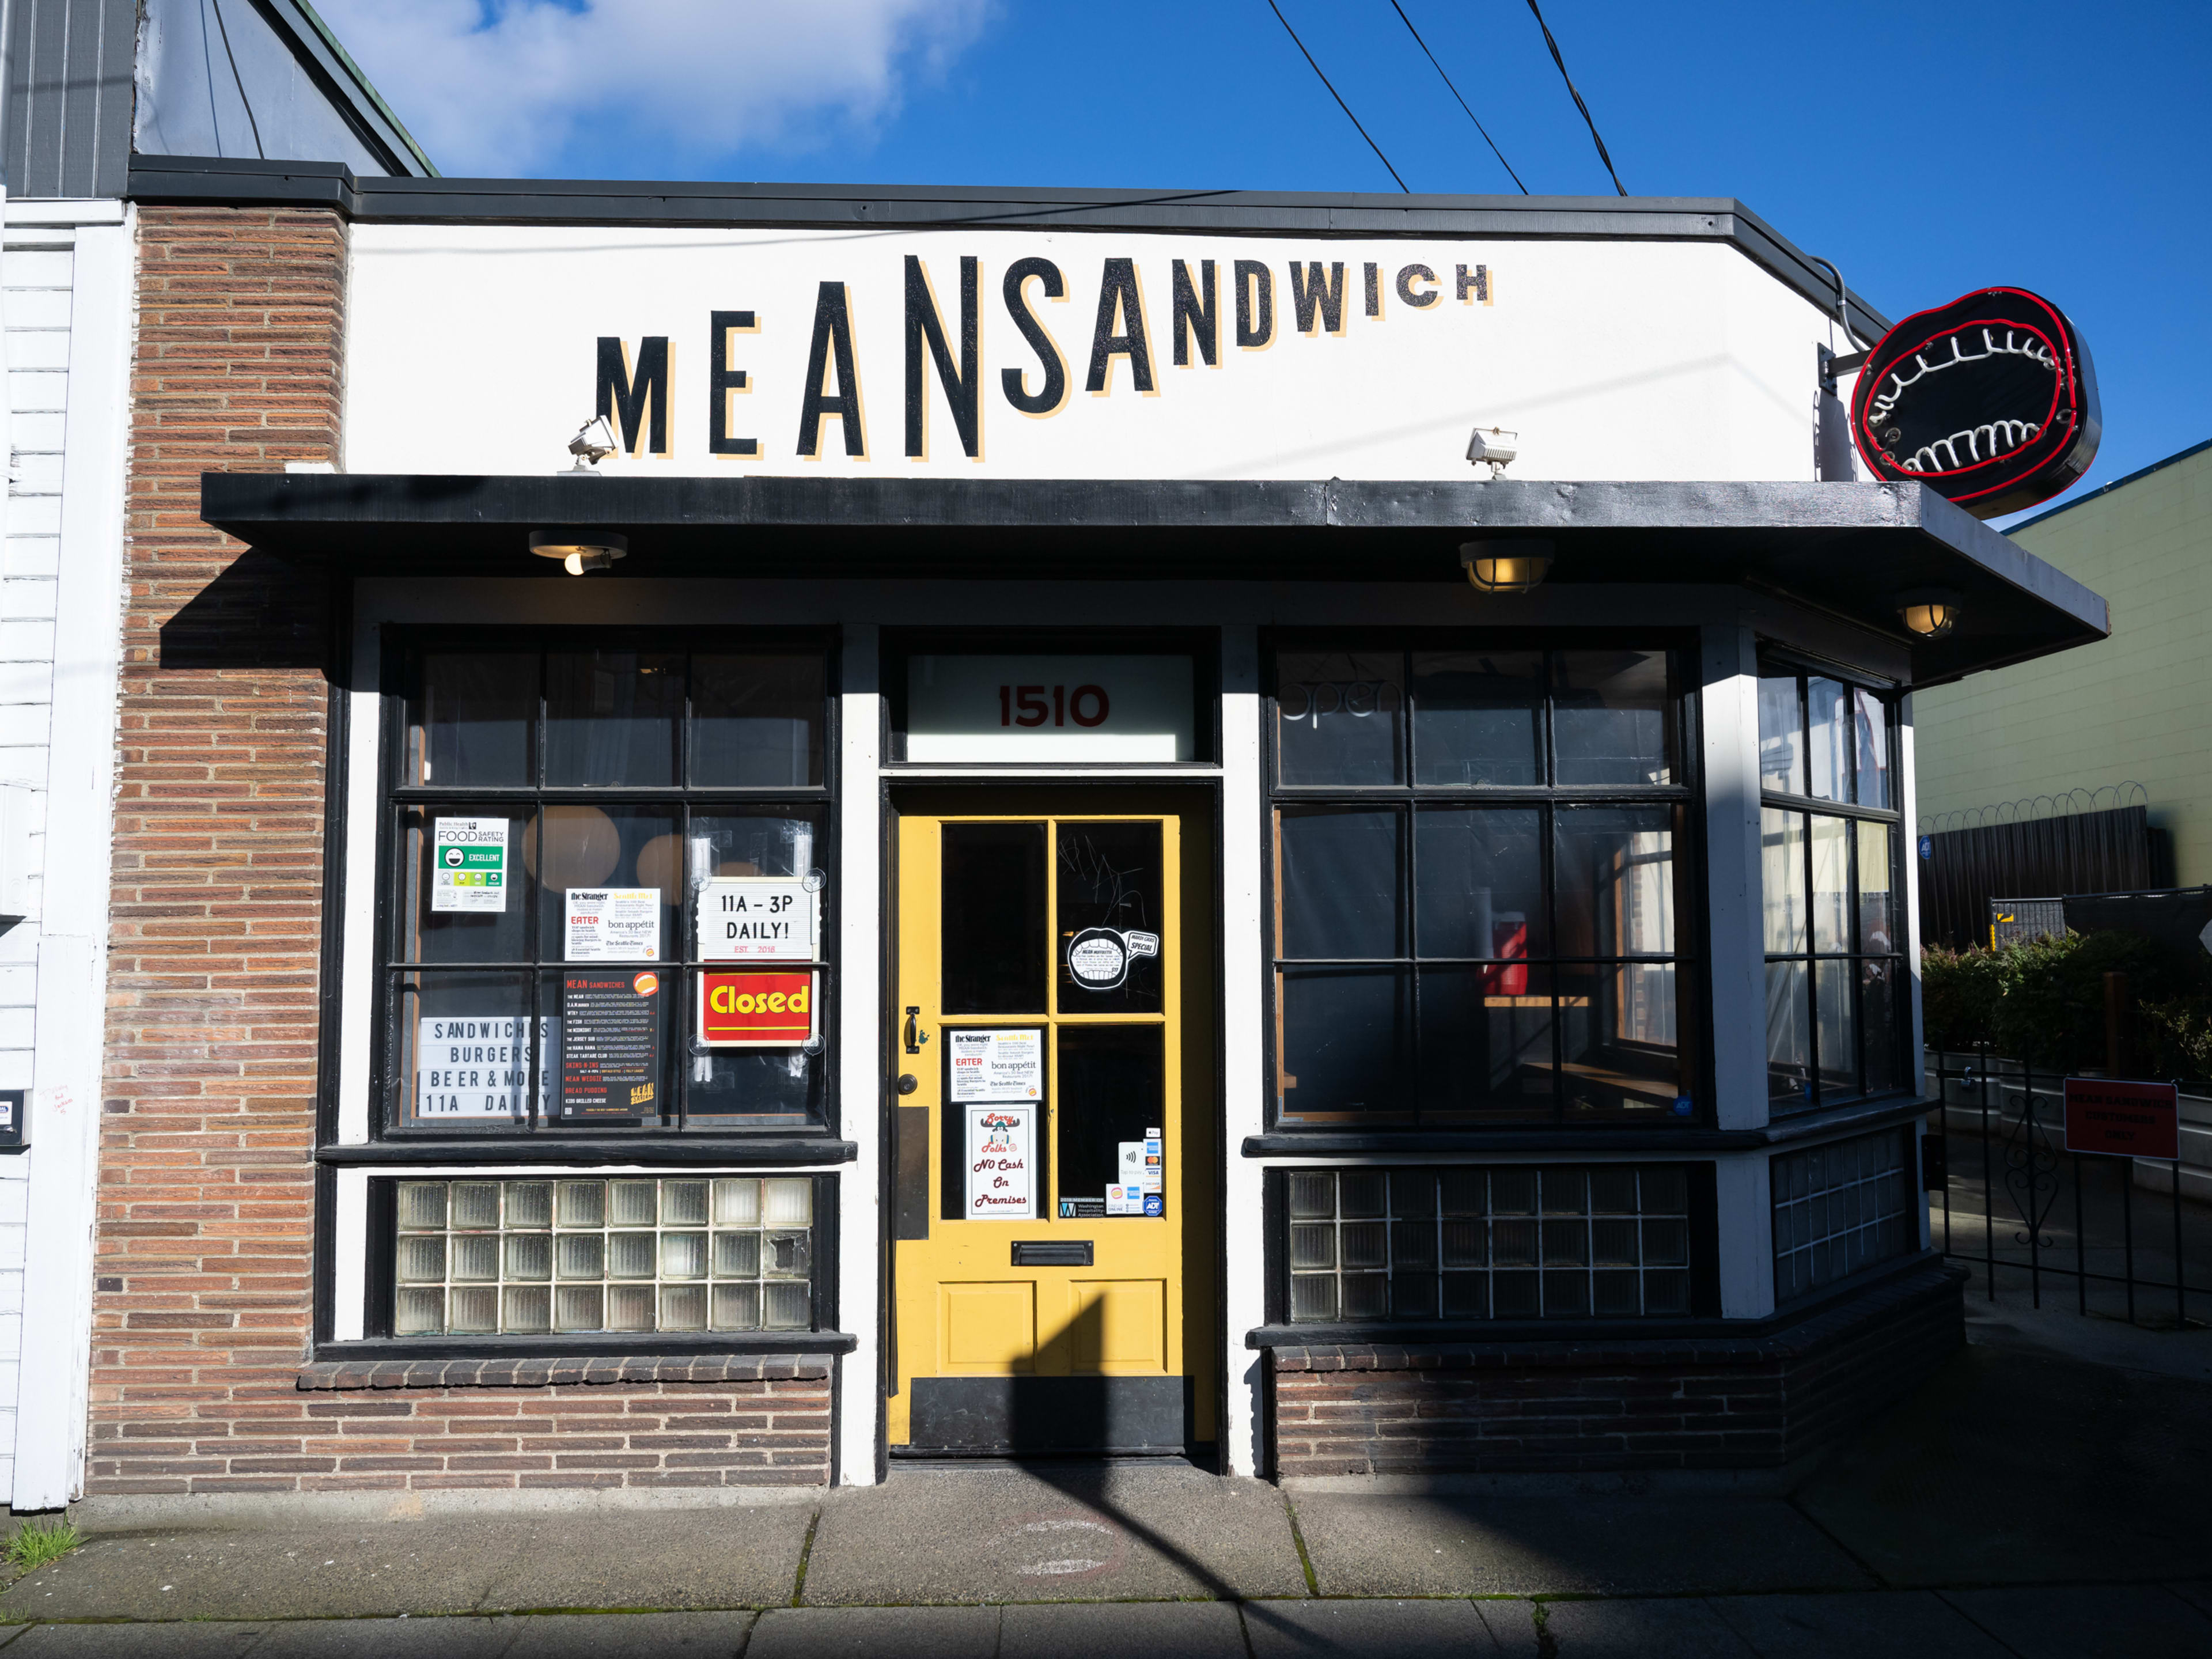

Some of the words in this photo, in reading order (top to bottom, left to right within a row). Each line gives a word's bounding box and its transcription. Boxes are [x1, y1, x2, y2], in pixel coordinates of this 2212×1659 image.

[999, 684, 1109, 727] 1510
[438, 831, 478, 842] FOOD
[582, 892, 608, 901] Stranger
[721, 895, 747, 912] 11A
[770, 895, 793, 914] 3P
[571, 916, 599, 924] EATER
[608, 920, 623, 928] bon
[626, 921, 654, 930] appétit
[727, 922, 789, 939] DAILY!
[1131, 942, 1152, 951] SPECIAL
[567, 980, 587, 988] MEAN
[710, 985, 809, 1014] Closed
[434, 1022, 548, 1039] SANDWICHS
[955, 1035, 965, 1043] the
[965, 1035, 991, 1043] Stranger
[991, 1061, 1007, 1069] bon
[1008, 1061, 1036, 1071] appétit
[431, 1070, 478, 1086] BEER
[488, 1070, 497, 1086] &
[505, 1070, 548, 1086] MOE
[426, 1094, 458, 1112] 11A
[2068, 1093, 2101, 1104] MEAN
[2106, 1096, 2173, 1109] SANDWICH
[986, 1113, 1014, 1124] Sorry
[2085, 1111, 2156, 1124] CUSTOMERS
[2104, 1129, 2135, 1141] ONLY
[982, 1142, 1007, 1153] Folks
[998, 1159, 1023, 1171] Cash
[993, 1176, 1009, 1188] On
[975, 1194, 1027, 1207] Premises
